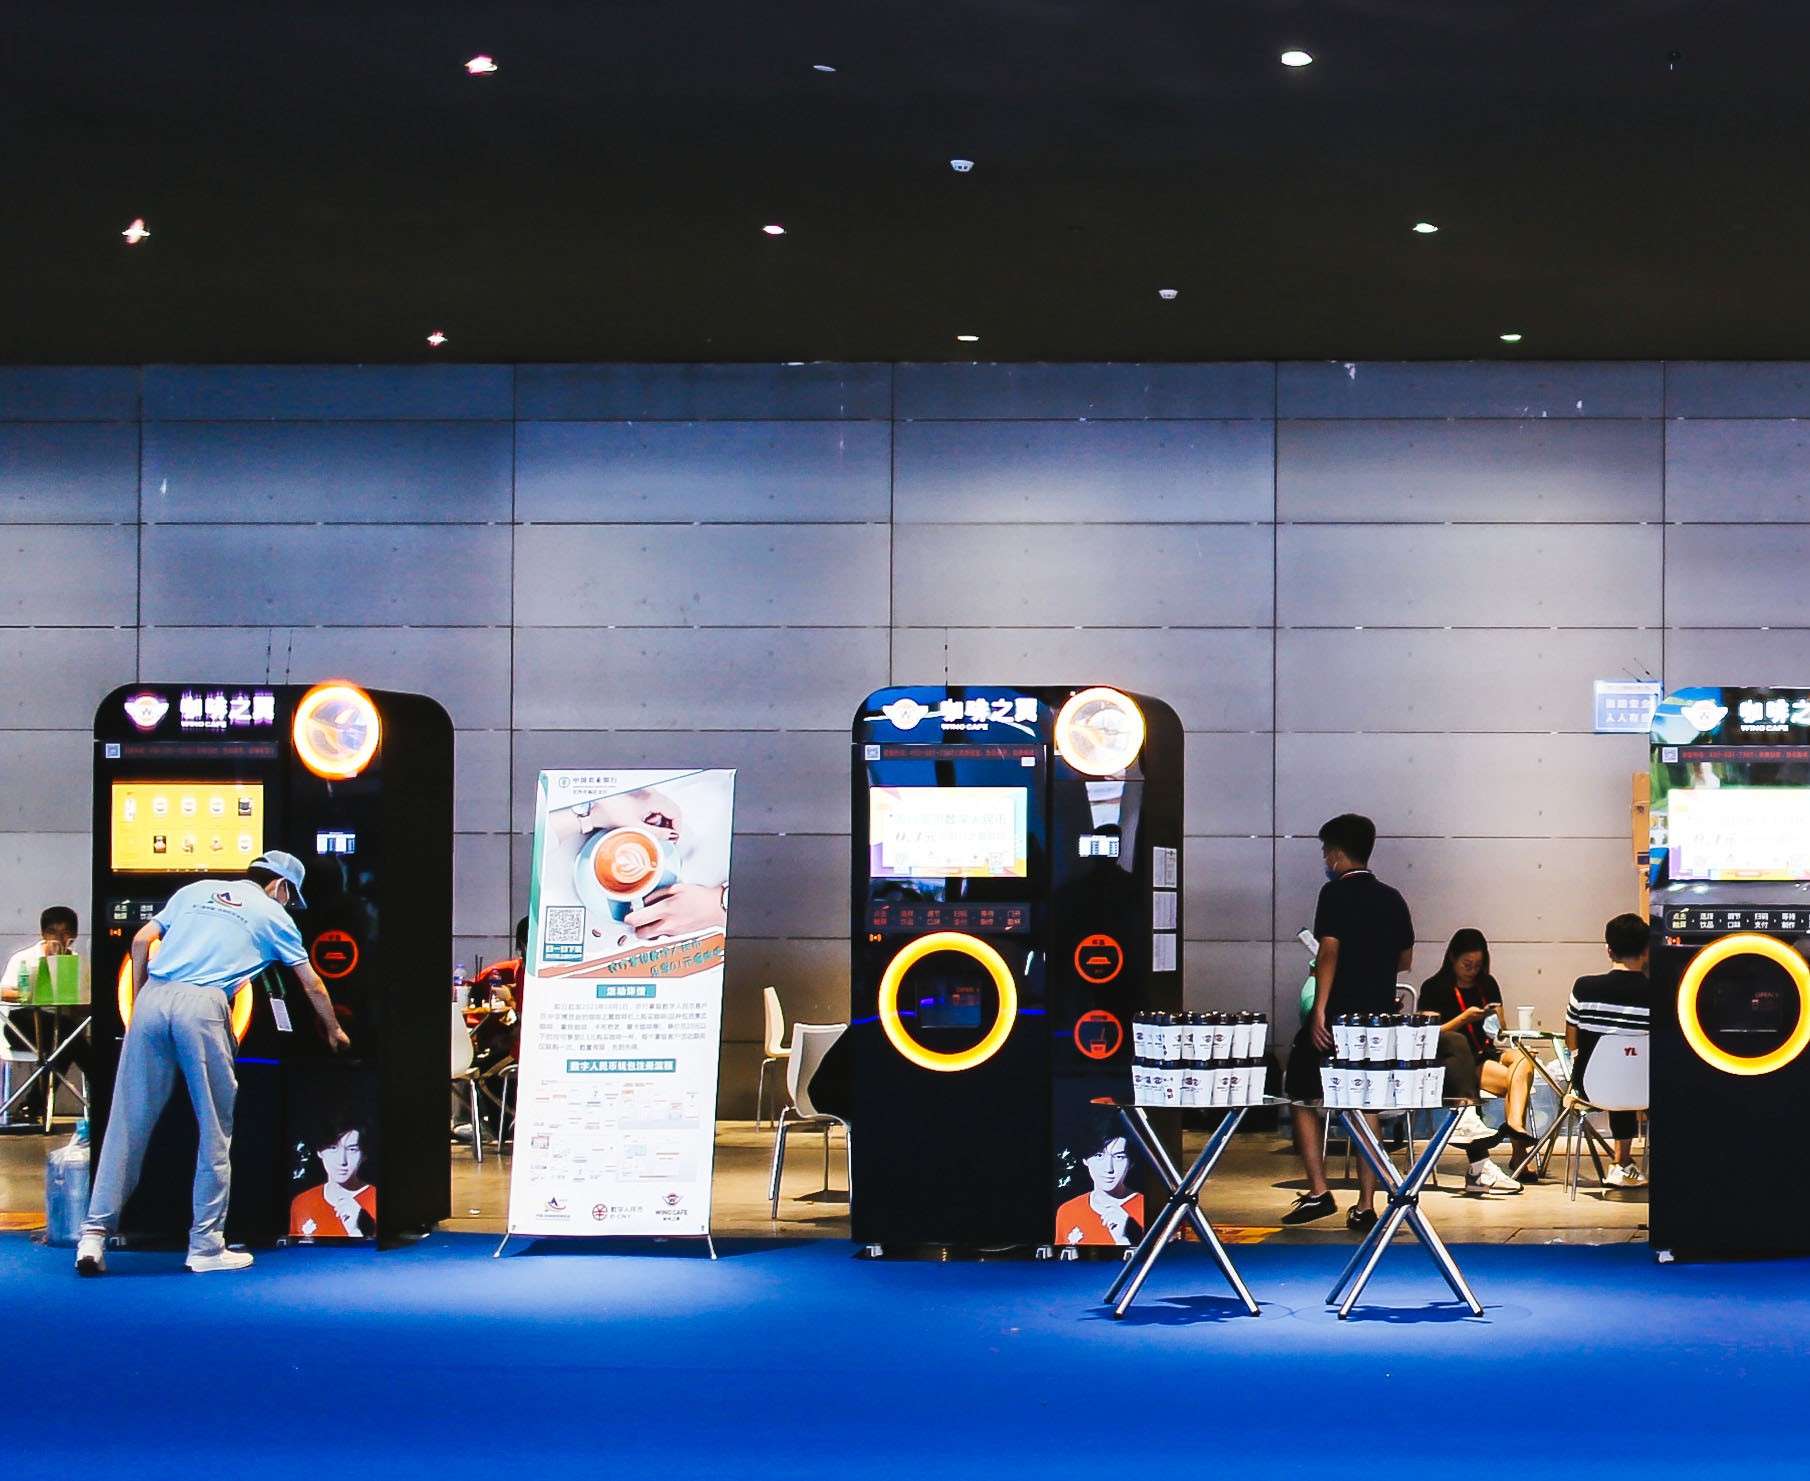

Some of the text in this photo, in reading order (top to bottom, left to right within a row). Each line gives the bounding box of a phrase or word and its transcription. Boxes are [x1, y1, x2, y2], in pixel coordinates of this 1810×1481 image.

[940, 698, 1038, 722] 咖啡之翼
[941, 723, 988, 731] WING CAFE
[1754, 912, 1769, 921] 扫码
[1727, 921, 1741, 929] 口味
[1754, 921, 1769, 929] 支付
[606, 986, 646, 996] 活动详情
[1624, 1047, 1638, 1056] YL
